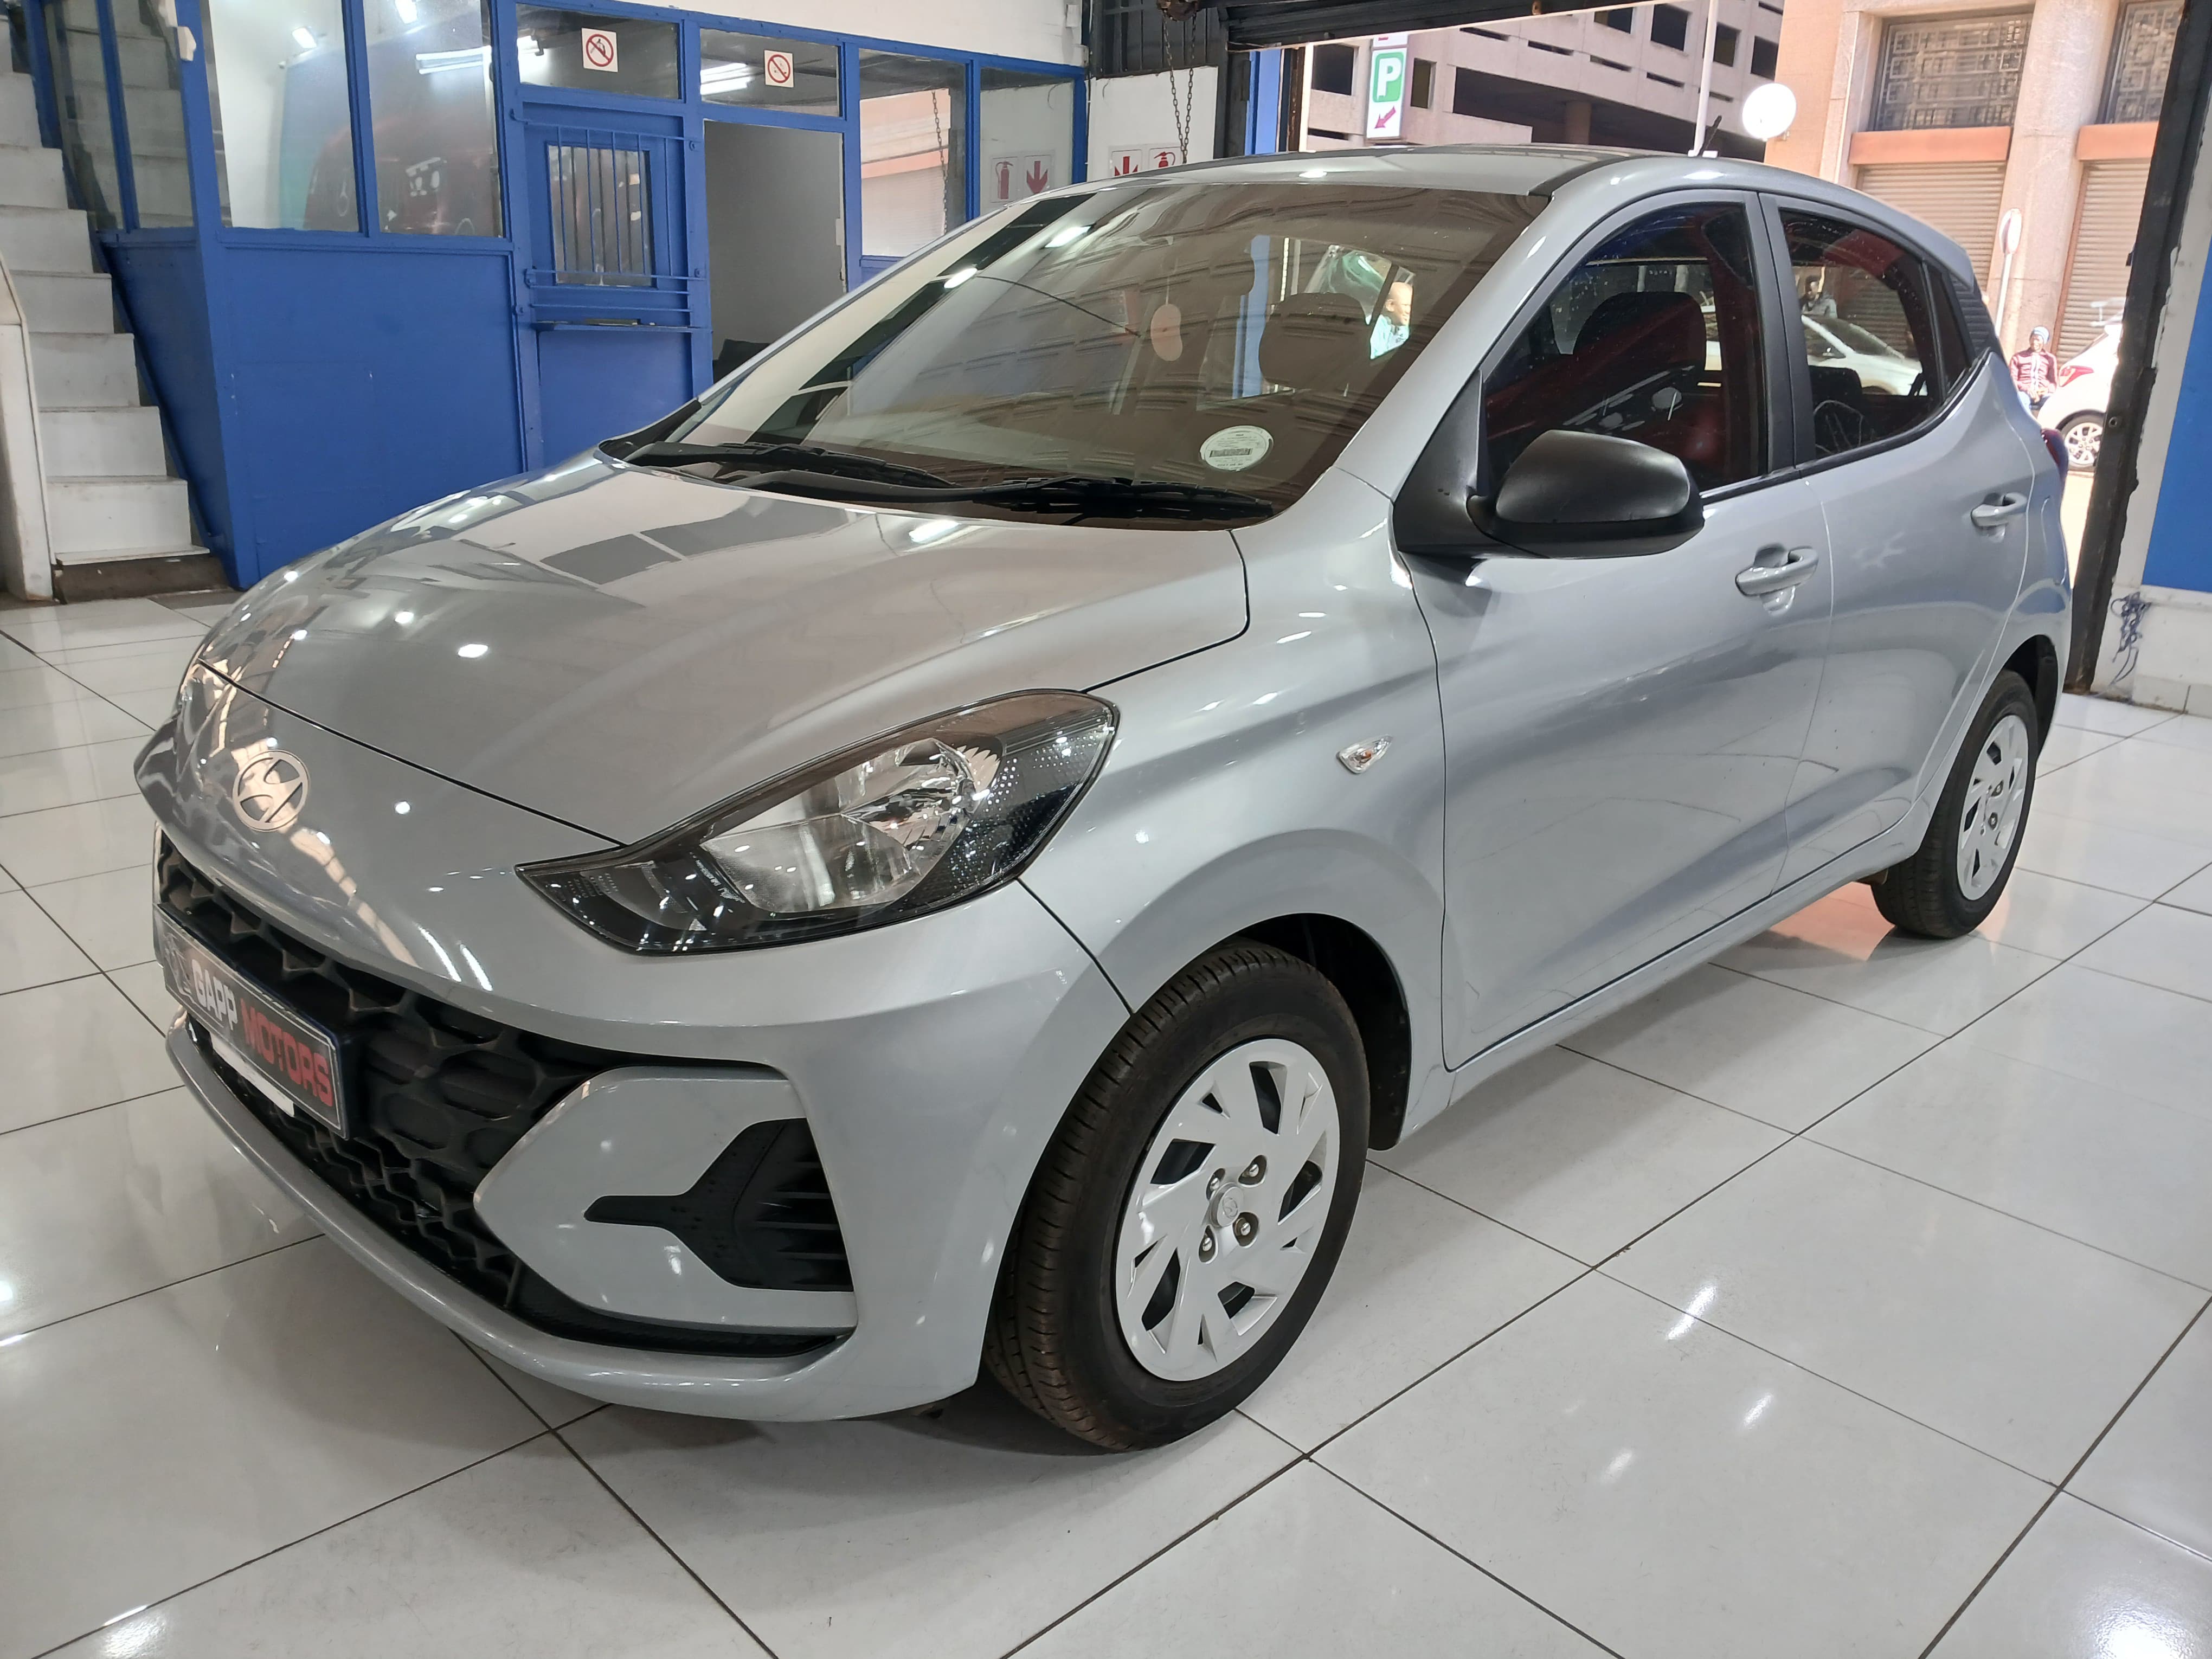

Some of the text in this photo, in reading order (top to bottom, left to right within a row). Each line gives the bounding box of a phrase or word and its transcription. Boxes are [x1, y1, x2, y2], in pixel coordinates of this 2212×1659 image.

[1377, 57, 1402, 100] P
[191, 959, 333, 1107] GAPP MOTORS
